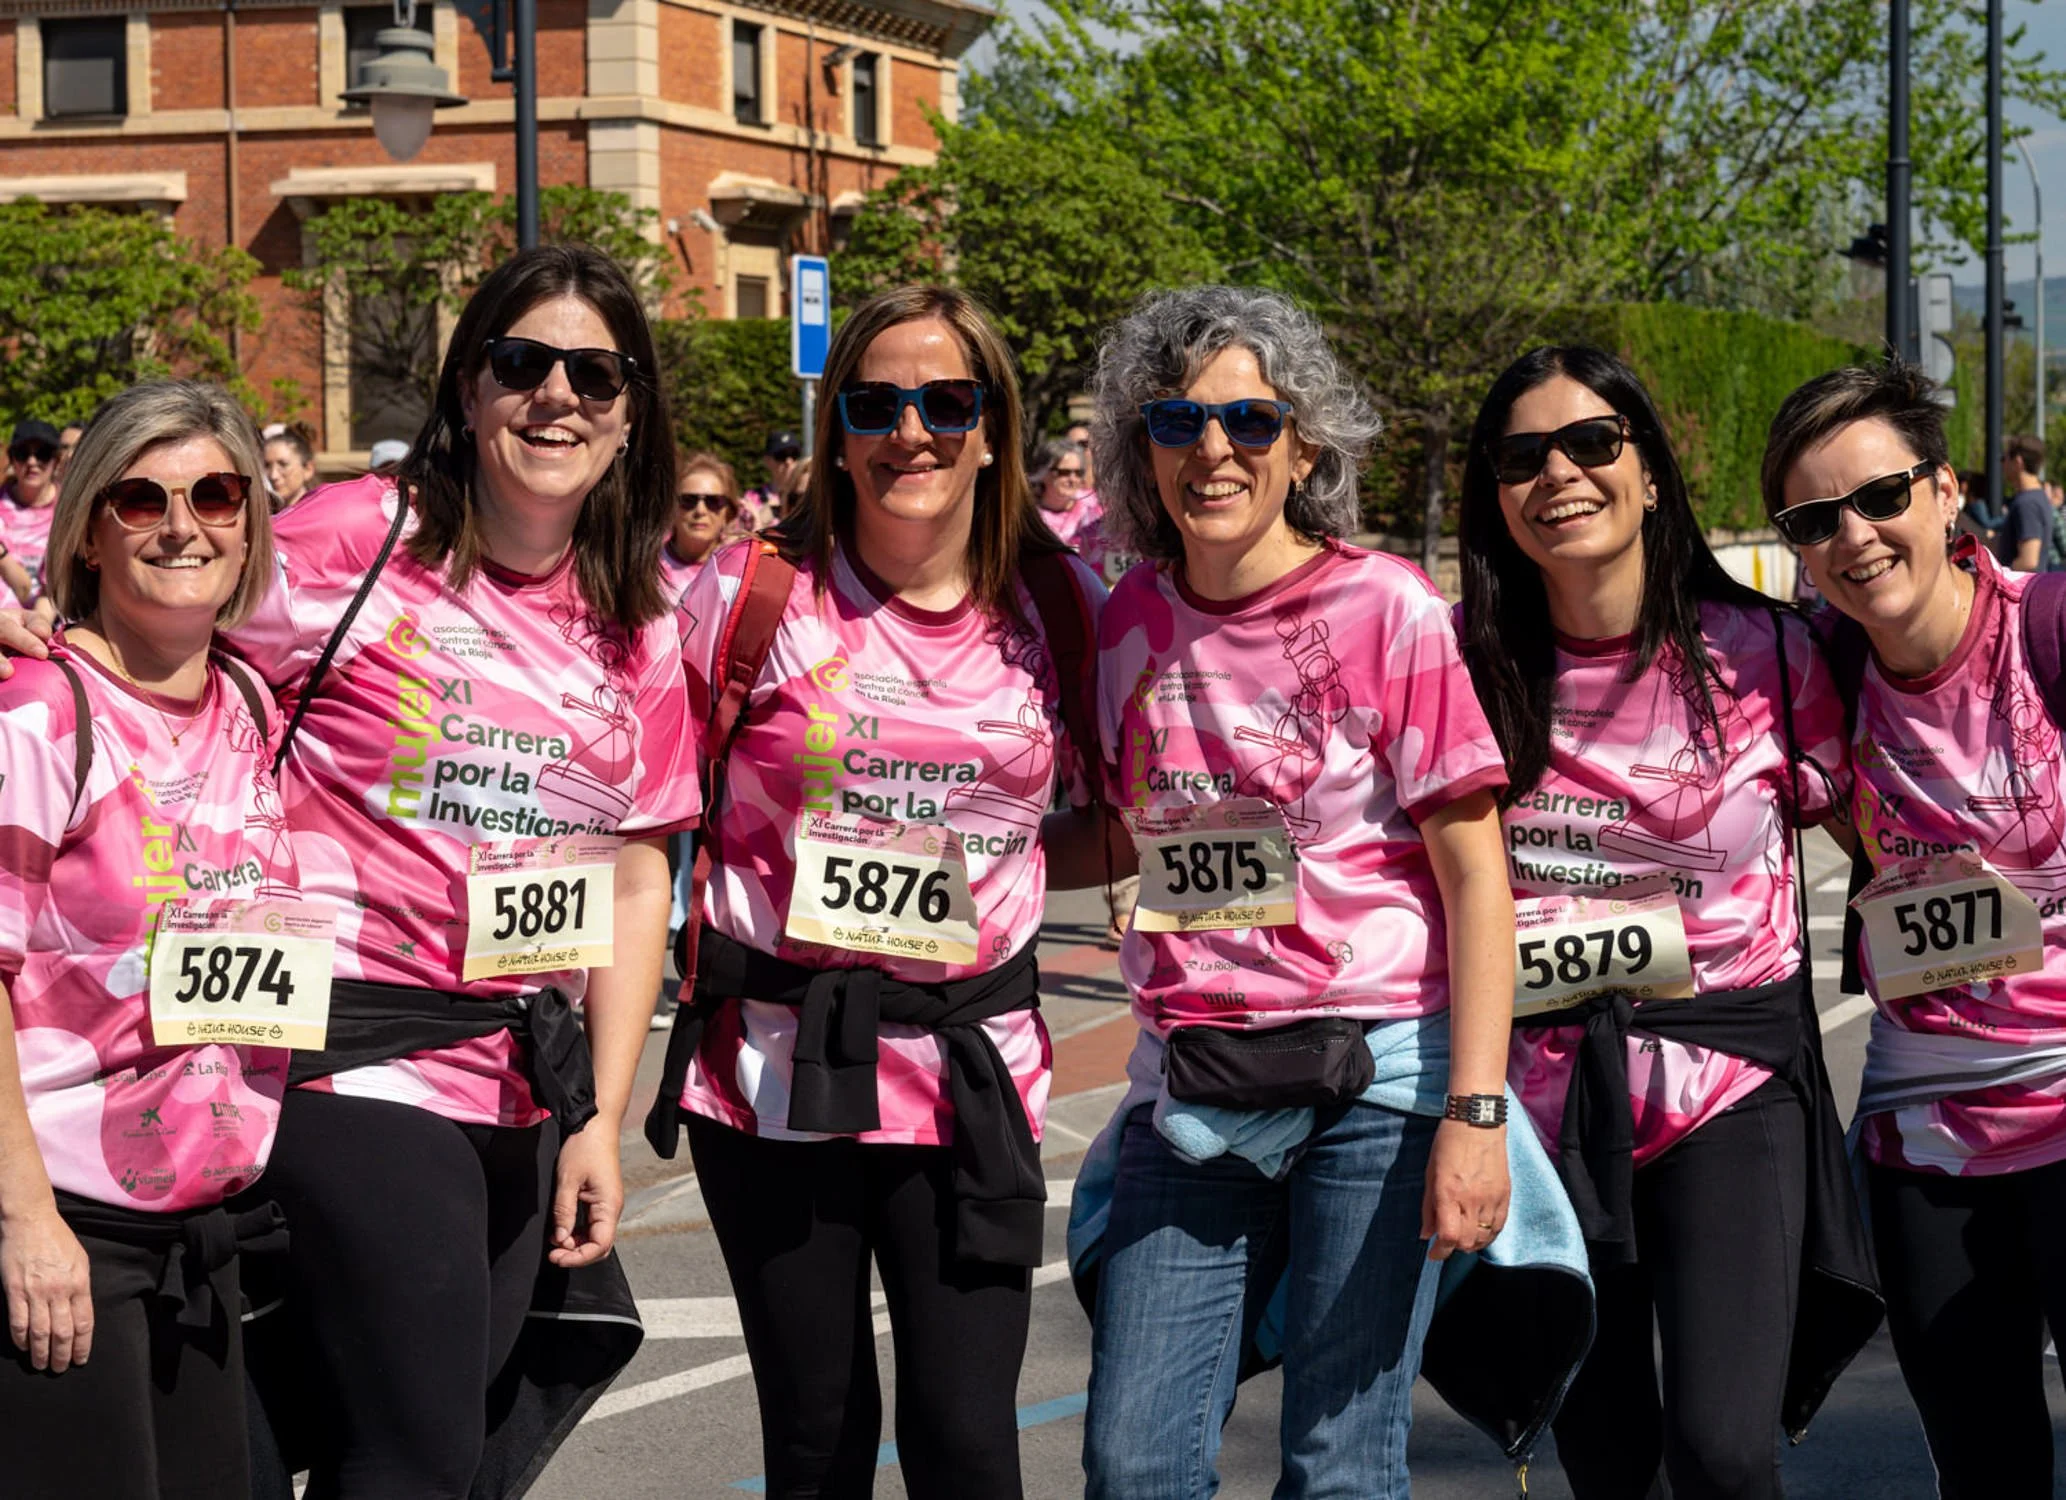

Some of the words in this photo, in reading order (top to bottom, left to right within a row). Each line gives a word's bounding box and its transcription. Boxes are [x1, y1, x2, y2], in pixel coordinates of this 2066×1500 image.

[436, 678, 473, 705] XI
[440, 713, 567, 760] Carrera
[846, 712, 879, 740] XI
[1149, 727, 1169, 755] XI
[386, 671, 442, 819] mujer
[433, 759, 496, 789] por
[500, 762, 530, 795] la
[843, 749, 976, 783] Carrera
[1147, 765, 1232, 794] Carrera
[842, 790, 899, 819] por
[906, 791, 937, 819] la
[176, 823, 198, 852] XI
[811, 817, 824, 829] XI
[824, 822, 858, 834] Carrera
[859, 827, 875, 839] por
[1510, 824, 1558, 851] por
[1565, 825, 1593, 852] la
[184, 861, 264, 890] Carrera
[1158, 841, 1267, 894] 5875
[1512, 856, 1704, 899] Investigón
[820, 856, 951, 923] 5876
[492, 877, 586, 940] 5881
[1894, 887, 2002, 956] 5877
[1200, 962, 1213, 972] La
[1519, 925, 1653, 989] 5879
[175, 945, 295, 1006] 5874
[198, 1063, 213, 1075] La
